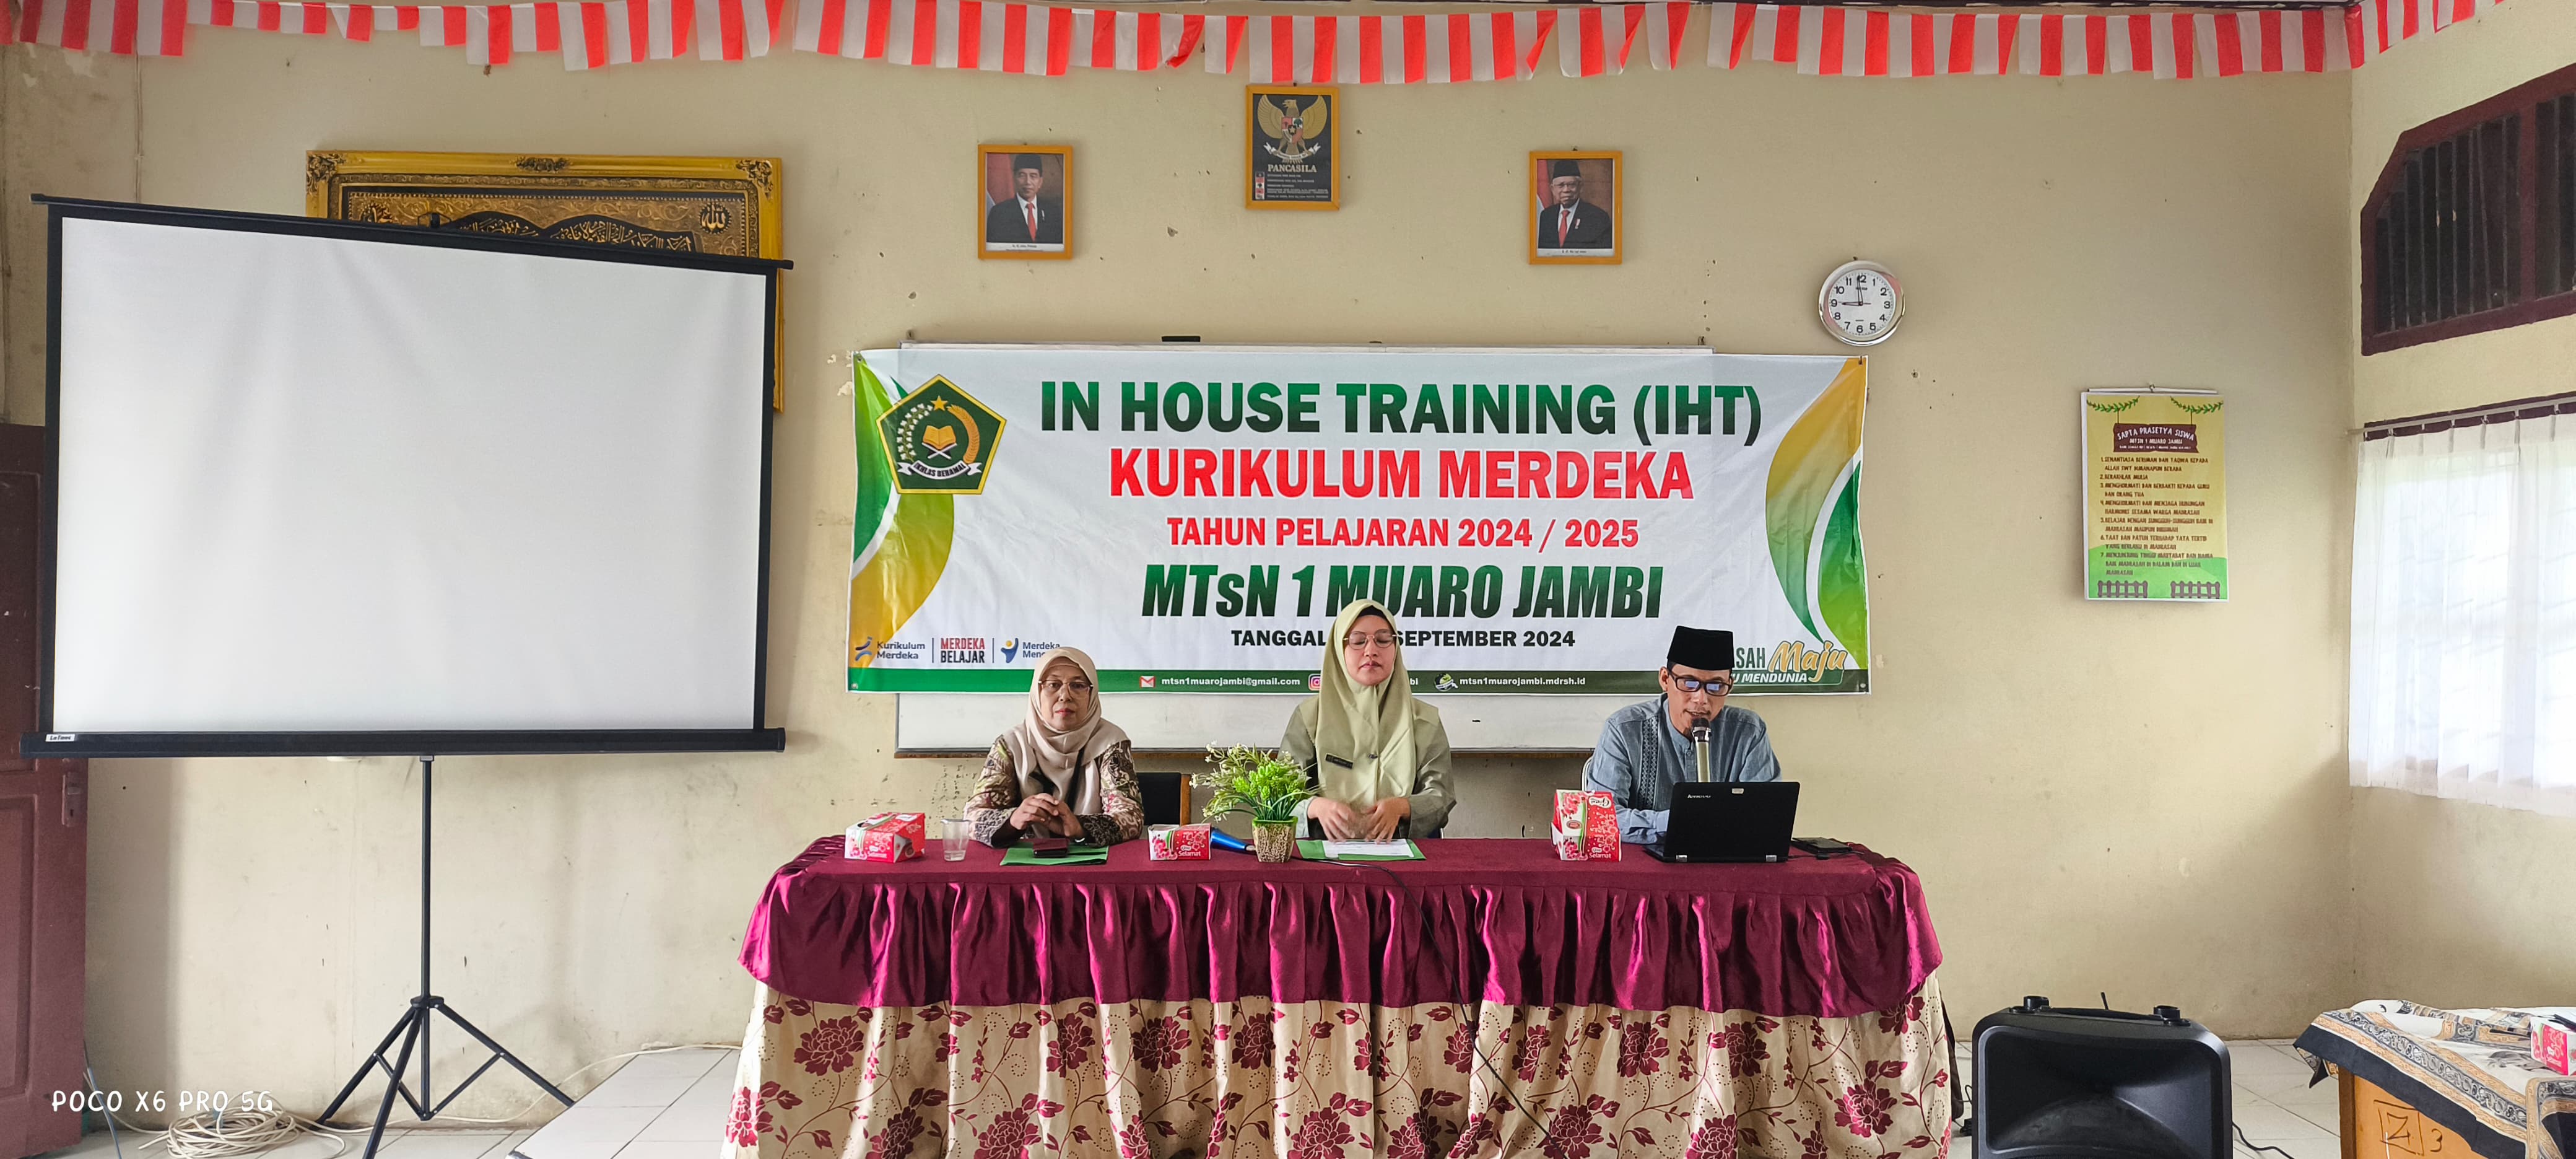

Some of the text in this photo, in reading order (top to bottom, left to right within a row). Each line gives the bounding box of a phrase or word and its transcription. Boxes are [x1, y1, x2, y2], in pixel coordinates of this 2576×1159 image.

[1268, 164, 1317, 173] PANCASILA
[1846, 277, 1852, 286] 11
[1836, 286, 1887, 296] 10 2
[1831, 299, 1891, 309] 9 3
[1834, 312, 1841, 320] 8
[1844, 321, 1876, 333] 7 6 5
[1042, 382, 1761, 446] IN HOUSE TRAINING (IHT)
[2117, 427, 2195, 440] SAPTA PRASETYA SISWA
[1110, 448, 1694, 499] KURIKULUM MERDEKA
[1167, 517, 1638, 553] TAHUN PELAJARAN 2024 / 2025
[1141, 564, 1663, 618] MTsN 1 MUARO JAMBI
[941, 638, 985, 650] MERDEKA
[1231, 630, 1326, 647] TANGGAL
[1523, 631, 1575, 647] 2024
[877, 641, 925, 650] Kurikulum
[1022, 642, 1060, 650] Merdeka
[877, 651, 919, 660] Merdeka
[941, 650, 985, 663] BELAJAR
[1767, 640, 1848, 683] Maju
[1162, 677, 1586, 686] mtsn1muarojambi@gmail.com mtsn1muarojambi.mdrsh.id
[1741, 673, 1808, 683] MENDUNIA
[2430, 1128, 2443, 1153] 3
